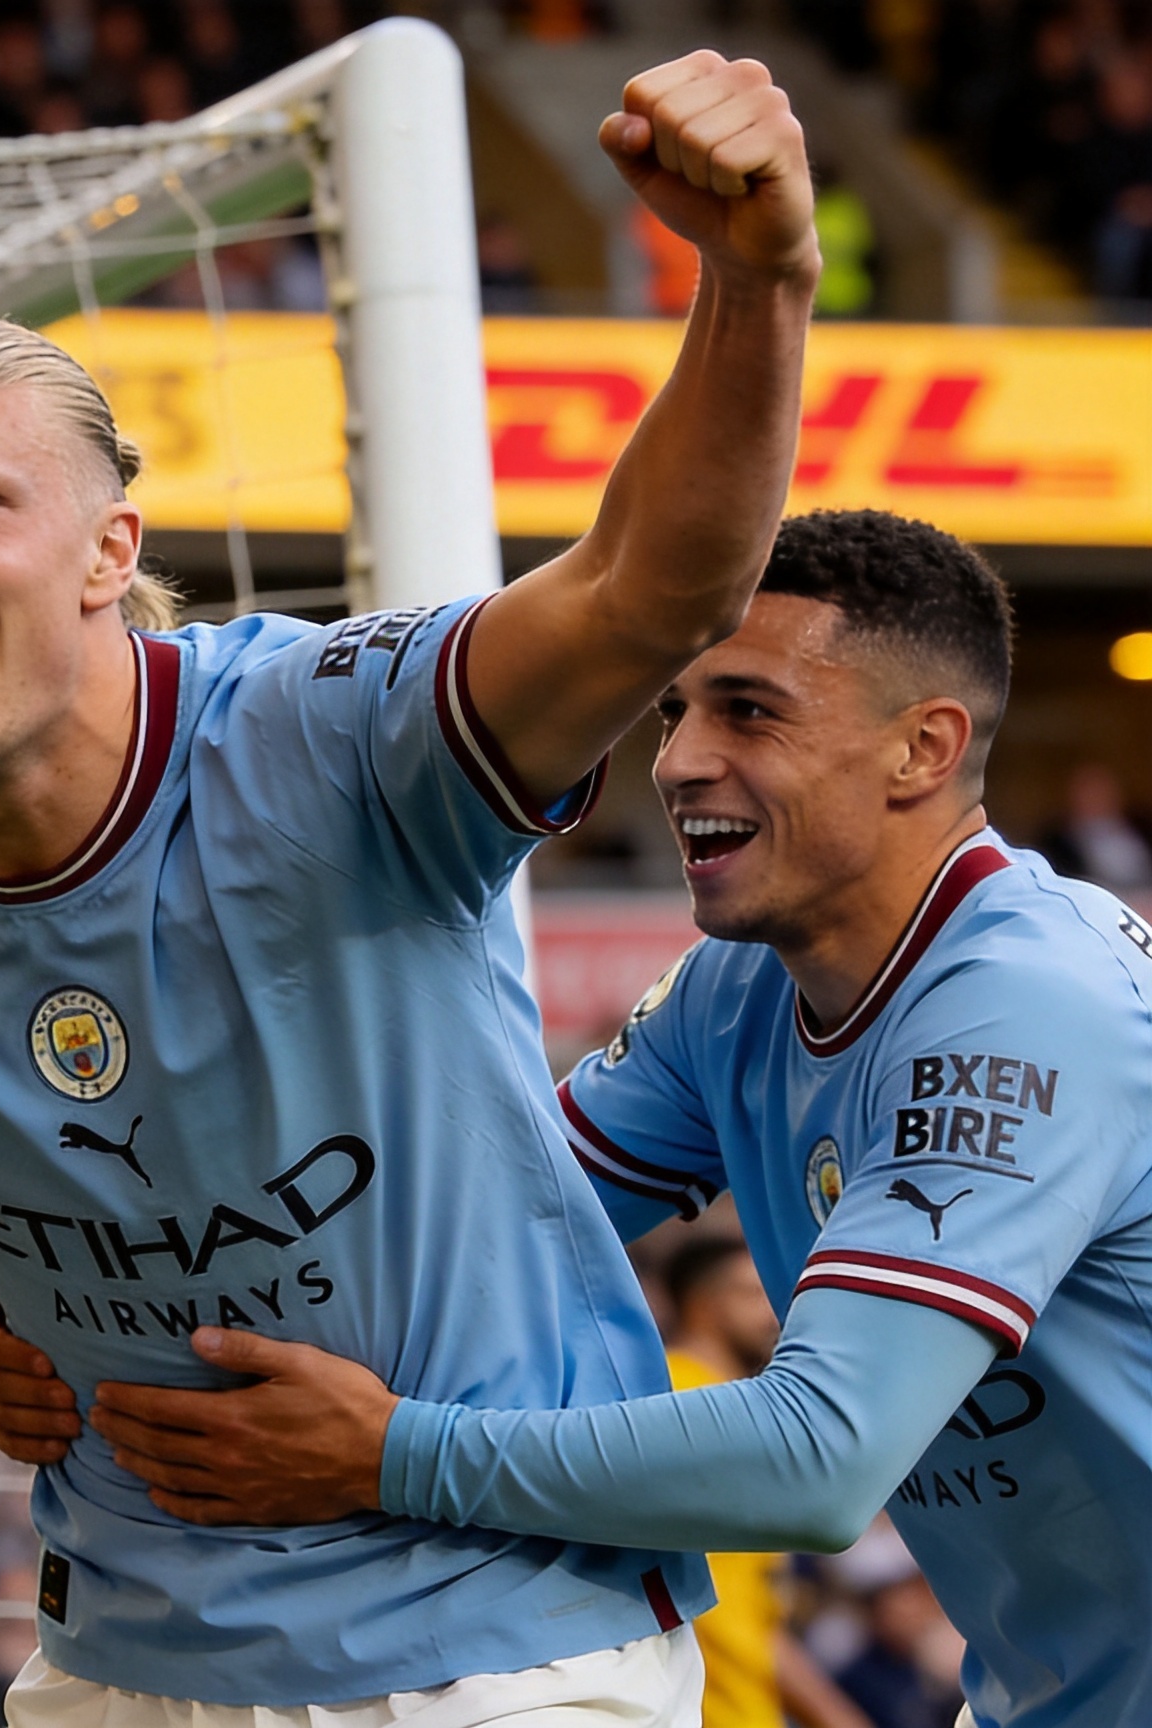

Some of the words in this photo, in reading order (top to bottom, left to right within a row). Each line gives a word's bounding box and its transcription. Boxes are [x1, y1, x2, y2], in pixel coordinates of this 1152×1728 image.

[911, 1053, 1059, 1117] BXEN
[893, 1106, 1024, 1165] BIRE
[54, 1259, 334, 1338] AIRWAYS
